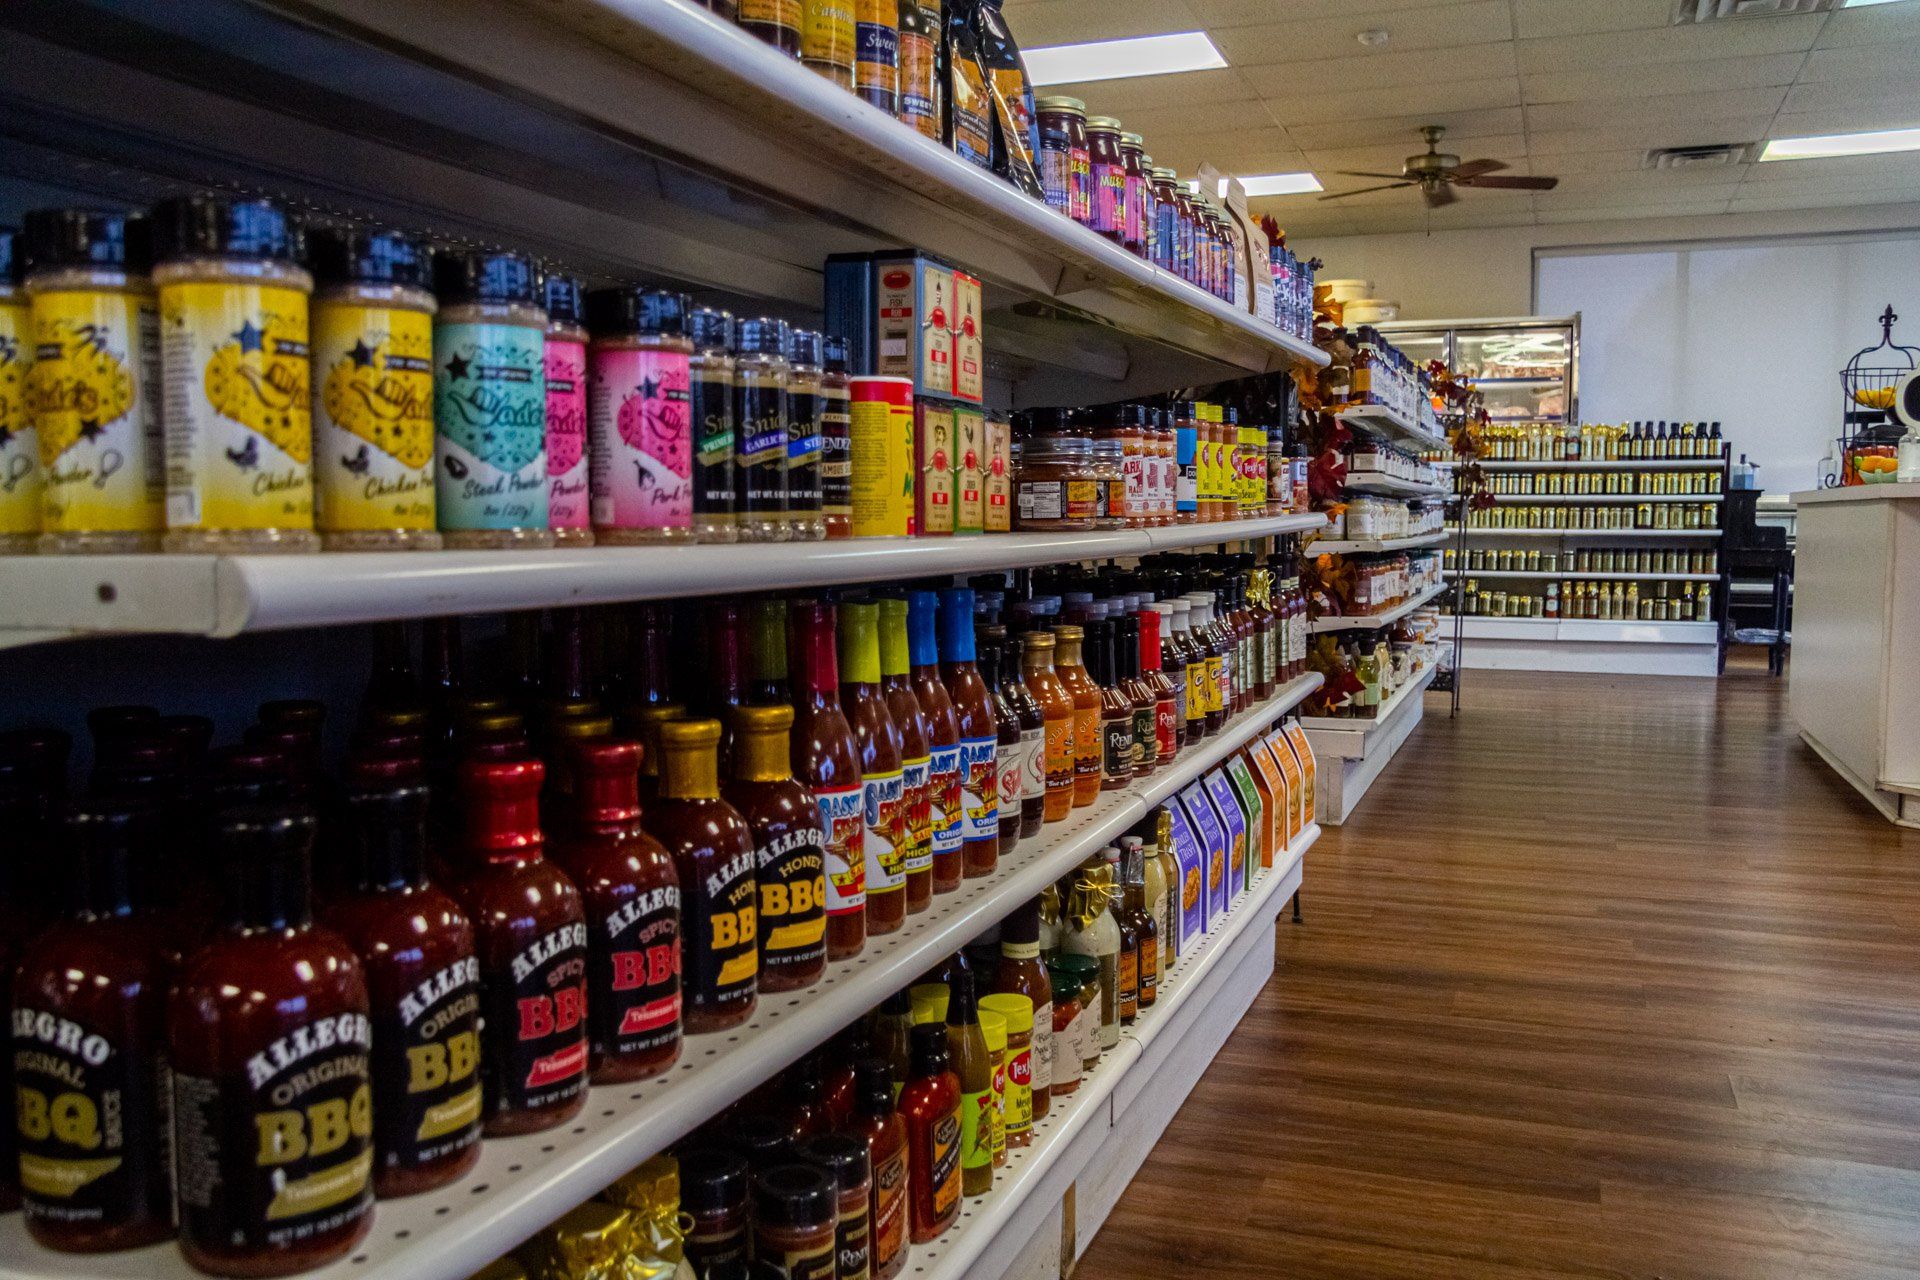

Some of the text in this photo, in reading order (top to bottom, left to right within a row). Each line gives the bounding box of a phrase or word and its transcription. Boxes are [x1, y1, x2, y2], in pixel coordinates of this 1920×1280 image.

[728, 879, 756, 906] HON
[778, 855, 823, 879] HONEY
[511, 922, 588, 984] ALLEG
[711, 905, 757, 951] BB
[517, 976, 588, 1042] BB
[406, 1030, 482, 1095] BB
